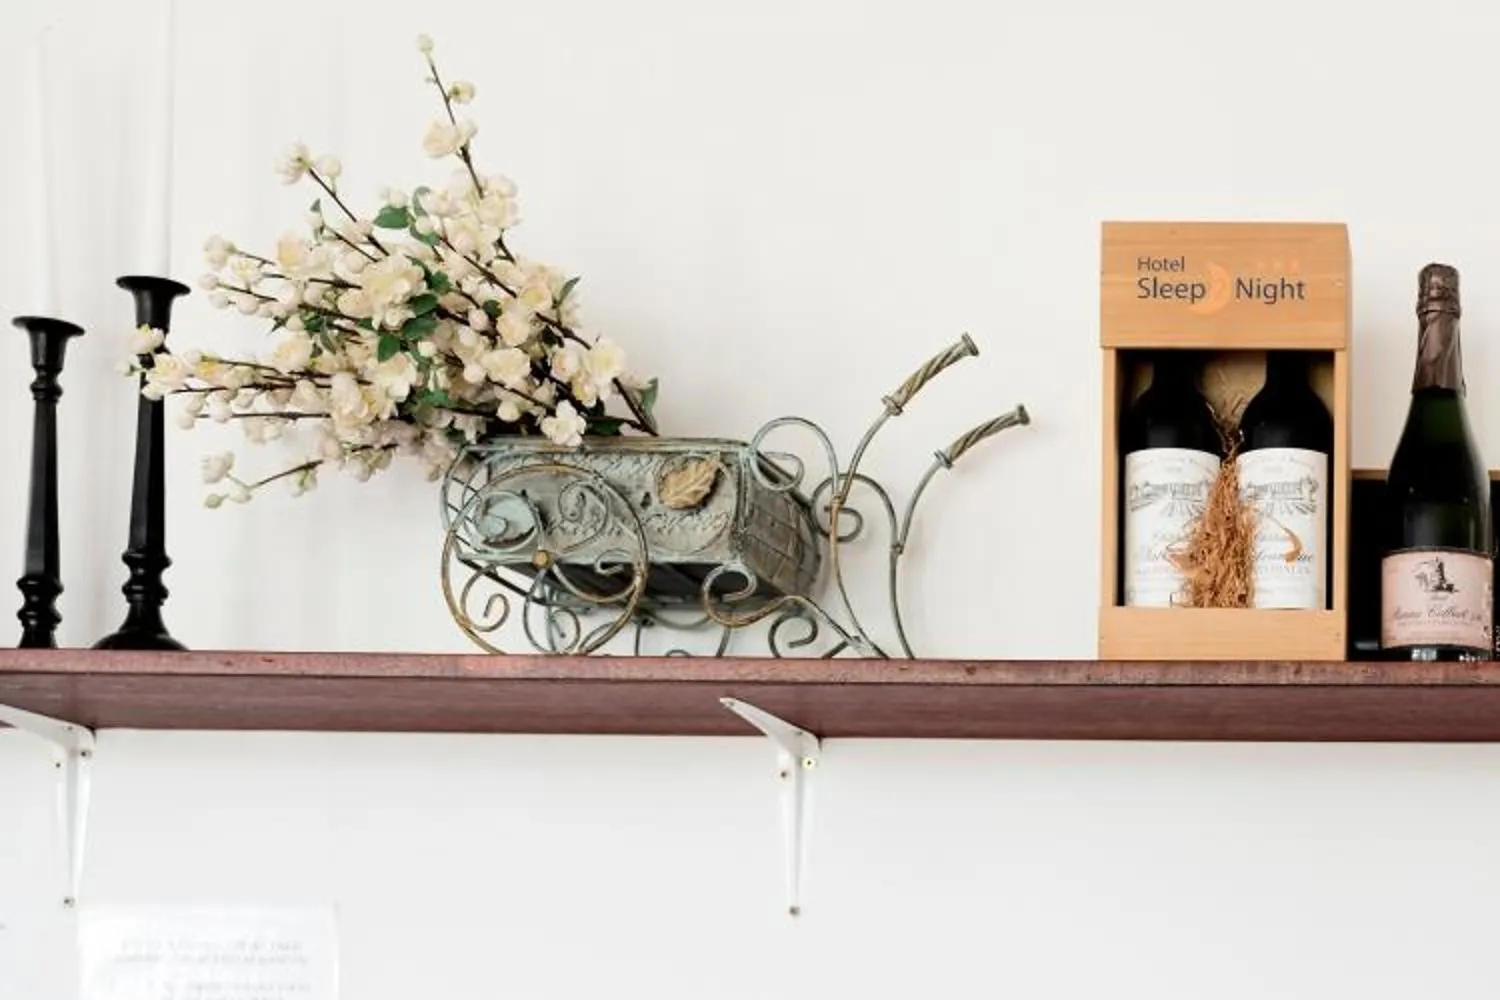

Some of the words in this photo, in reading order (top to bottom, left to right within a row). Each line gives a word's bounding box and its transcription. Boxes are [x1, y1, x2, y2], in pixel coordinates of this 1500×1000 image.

[1137, 255, 1185, 273] Hotel
[1137, 276, 1207, 305] Sleep
[1235, 277, 1306, 305] Night
